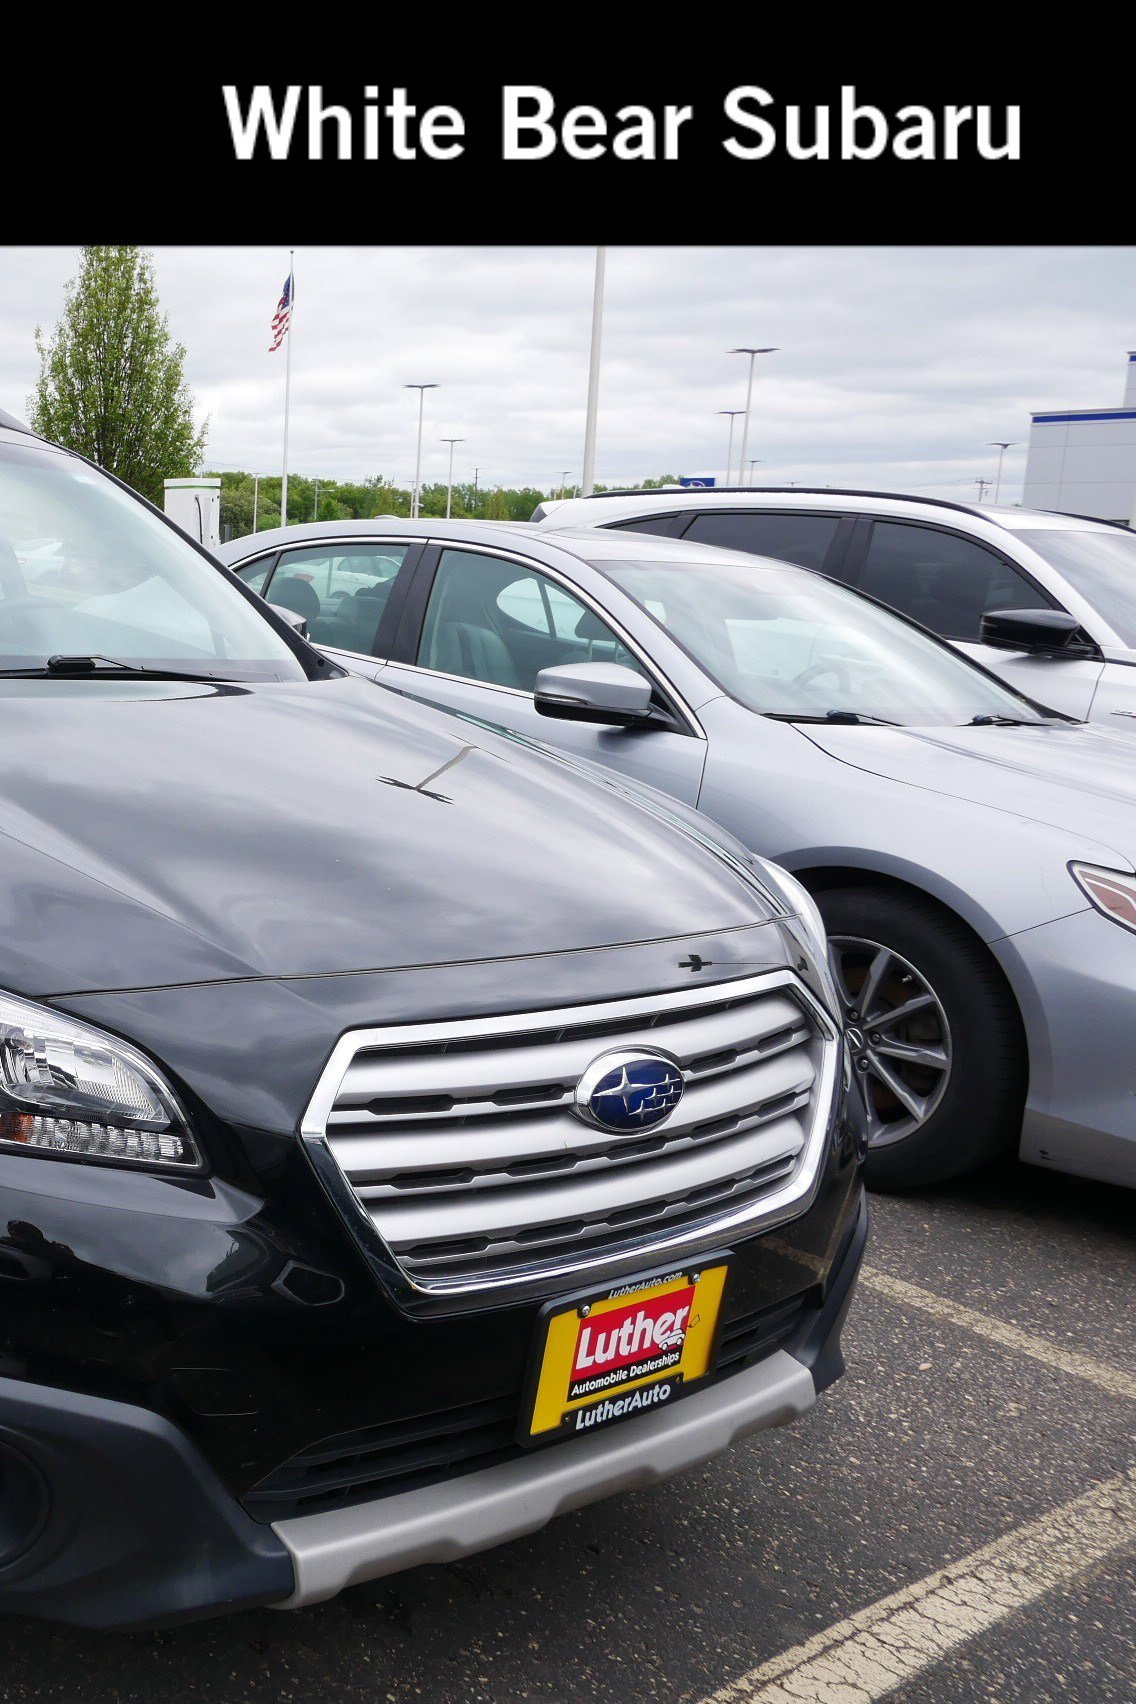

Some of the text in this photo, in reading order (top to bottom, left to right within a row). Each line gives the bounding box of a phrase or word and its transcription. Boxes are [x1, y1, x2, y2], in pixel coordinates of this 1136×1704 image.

[608, 1272, 683, 1299] LutherAuto.com
[575, 1305, 690, 1370] Luther
[571, 1352, 680, 1397] Automobile Dealerships
[576, 1385, 671, 1430] LutherAuto
